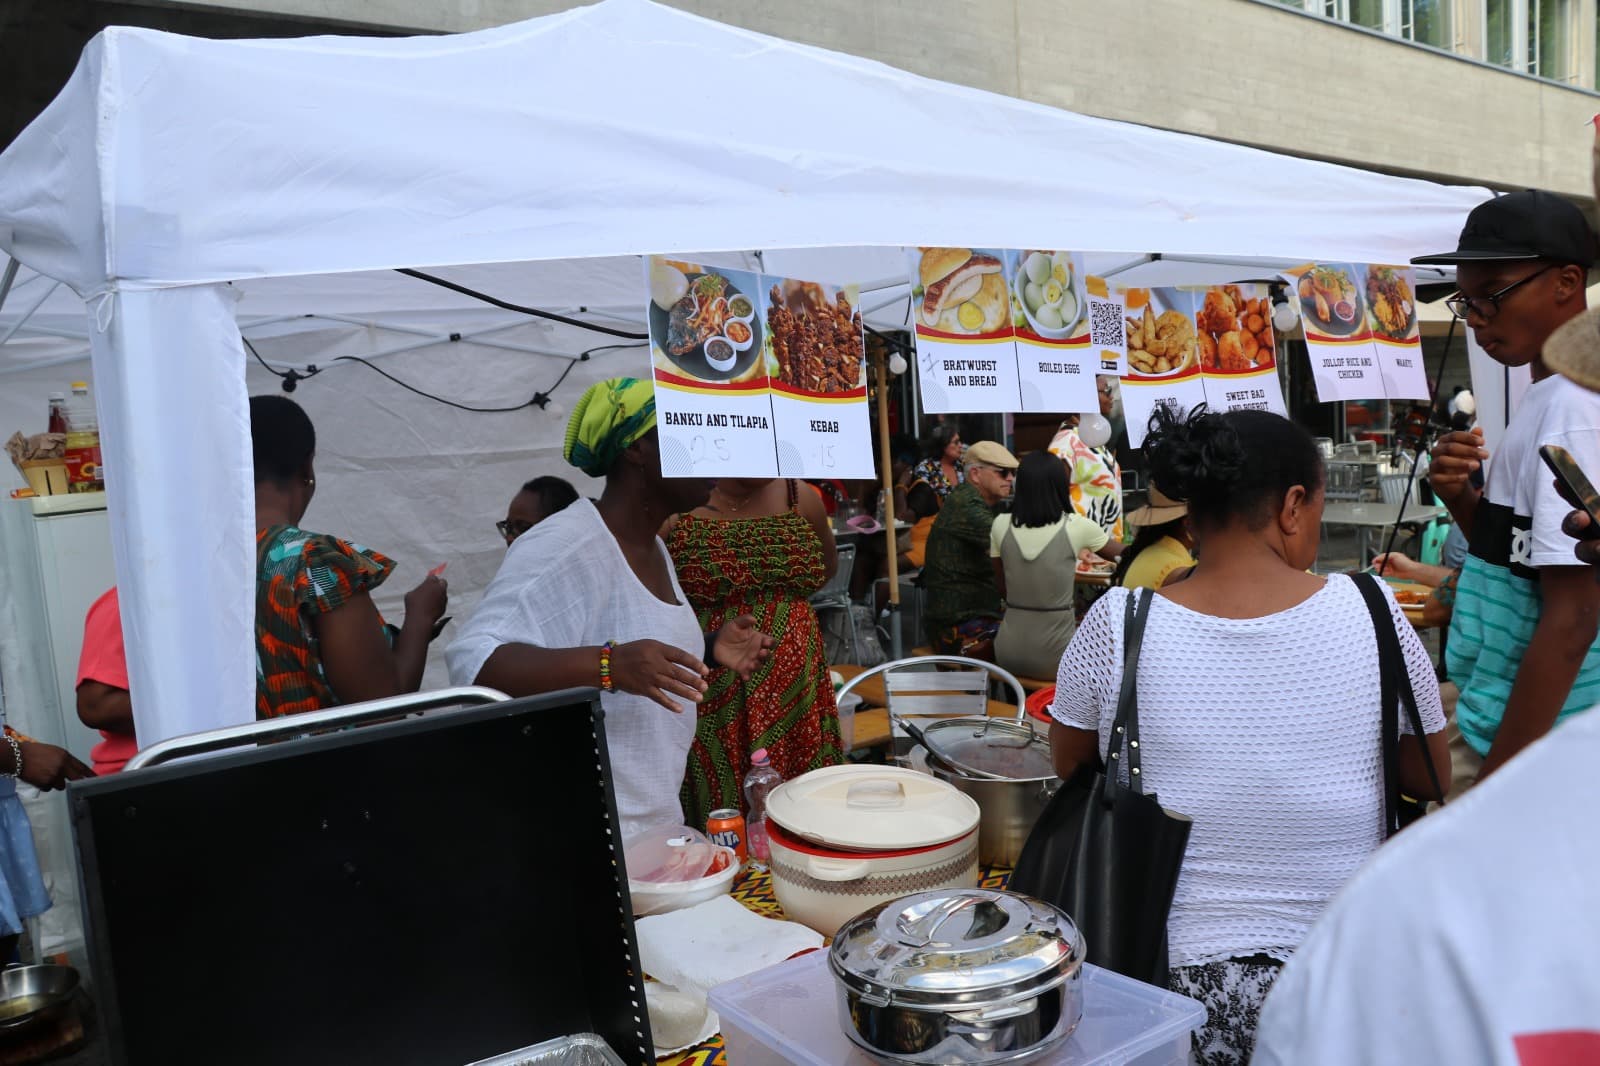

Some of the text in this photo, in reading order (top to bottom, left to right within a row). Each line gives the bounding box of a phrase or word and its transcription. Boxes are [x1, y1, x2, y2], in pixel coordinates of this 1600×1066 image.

[943, 360, 997, 371] BRATWURST
[1323, 357, 1372, 367] JOLLOF RICE AND
[1039, 362, 1081, 374] BOILED EGGS
[1338, 369, 1364, 379] CHICKEN
[948, 375, 997, 386] AND BREAD
[1226, 389, 1265, 402] SWEET BAD
[665, 411, 769, 430] BANKU AND TILAPIA
[810, 420, 839, 432] KEBAB
